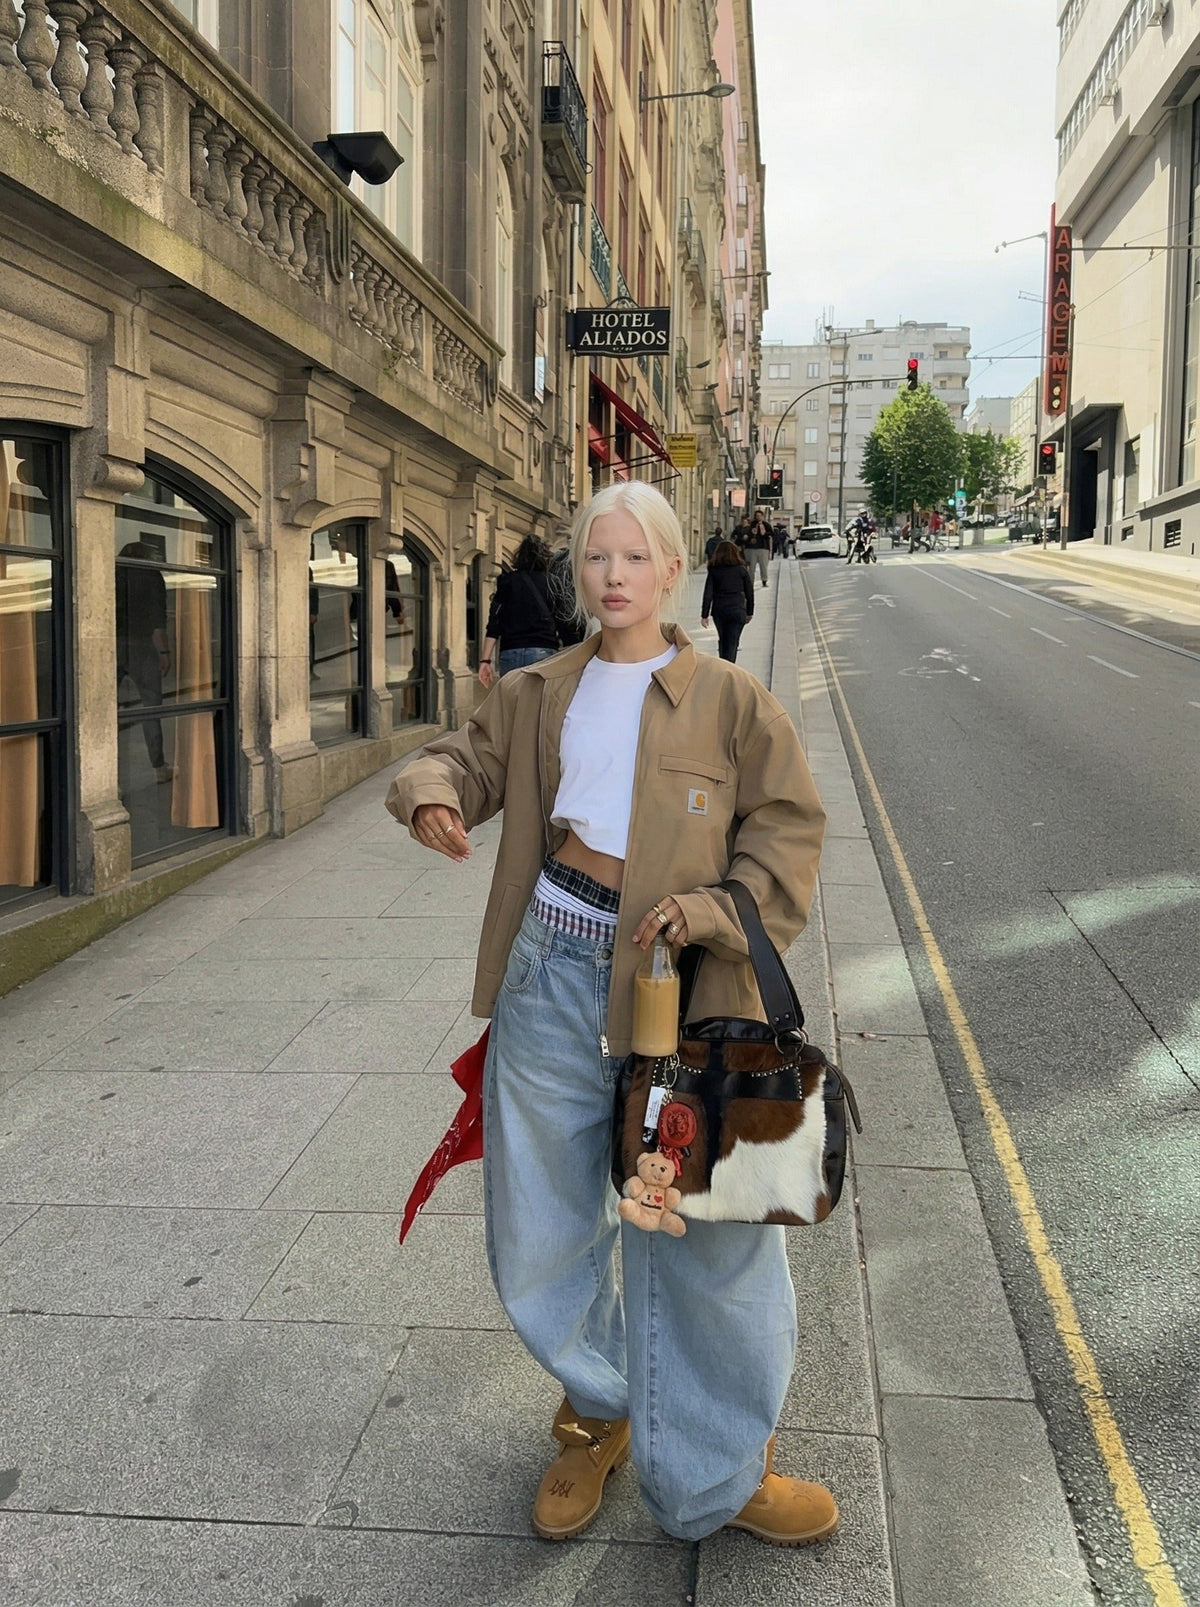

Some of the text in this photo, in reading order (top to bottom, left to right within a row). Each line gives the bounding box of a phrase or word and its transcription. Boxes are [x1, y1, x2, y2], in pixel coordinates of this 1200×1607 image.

[1052, 228, 1072, 371] ARAGEM
[590, 313, 655, 328] HOTEL
[579, 330, 667, 346] ALIADOS
